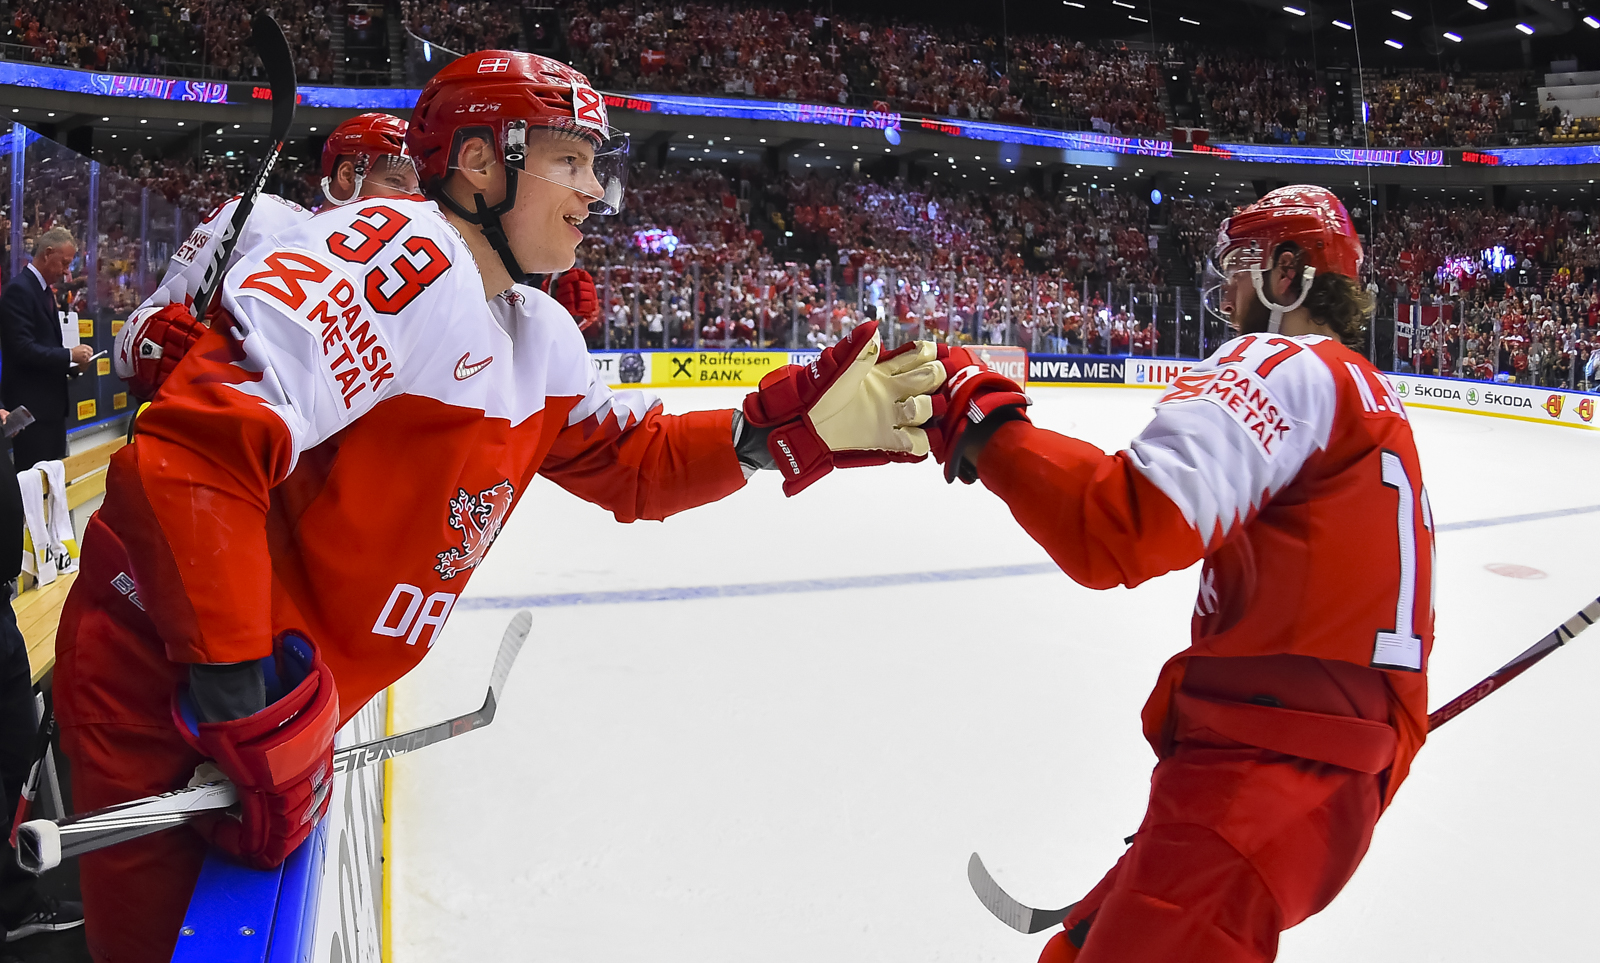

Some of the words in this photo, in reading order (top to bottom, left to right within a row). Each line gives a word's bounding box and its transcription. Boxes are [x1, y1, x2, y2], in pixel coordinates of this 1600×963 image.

[252, 86, 273, 100] SHO
[604, 95, 625, 107] SHOT
[627, 99, 652, 111] SPEED
[1462, 152, 1480, 163] SHOT
[1480, 154, 1499, 165] SPEED
[251, 151, 279, 204] EASTON
[1273, 208, 1311, 217] CCM
[326, 205, 452, 315] 33
[328, 278, 395, 392] DANSK
[306, 300, 366, 409] METAL
[699, 352, 771, 369] Raiffeisen
[1029, 361, 1082, 379] NIVEA
[1083, 363, 1124, 379] MEN
[1218, 335, 1303, 380] 17
[699, 369, 742, 382] BANK
[1218, 368, 1291, 441] DANSK
[1414, 384, 1461, 401] ŠKODA
[1484, 393, 1533, 409] ŠKODA
[1205, 382, 1272, 456] METAL
[371, 583, 457, 649] DA
[333, 729, 428, 774] STEALTH
